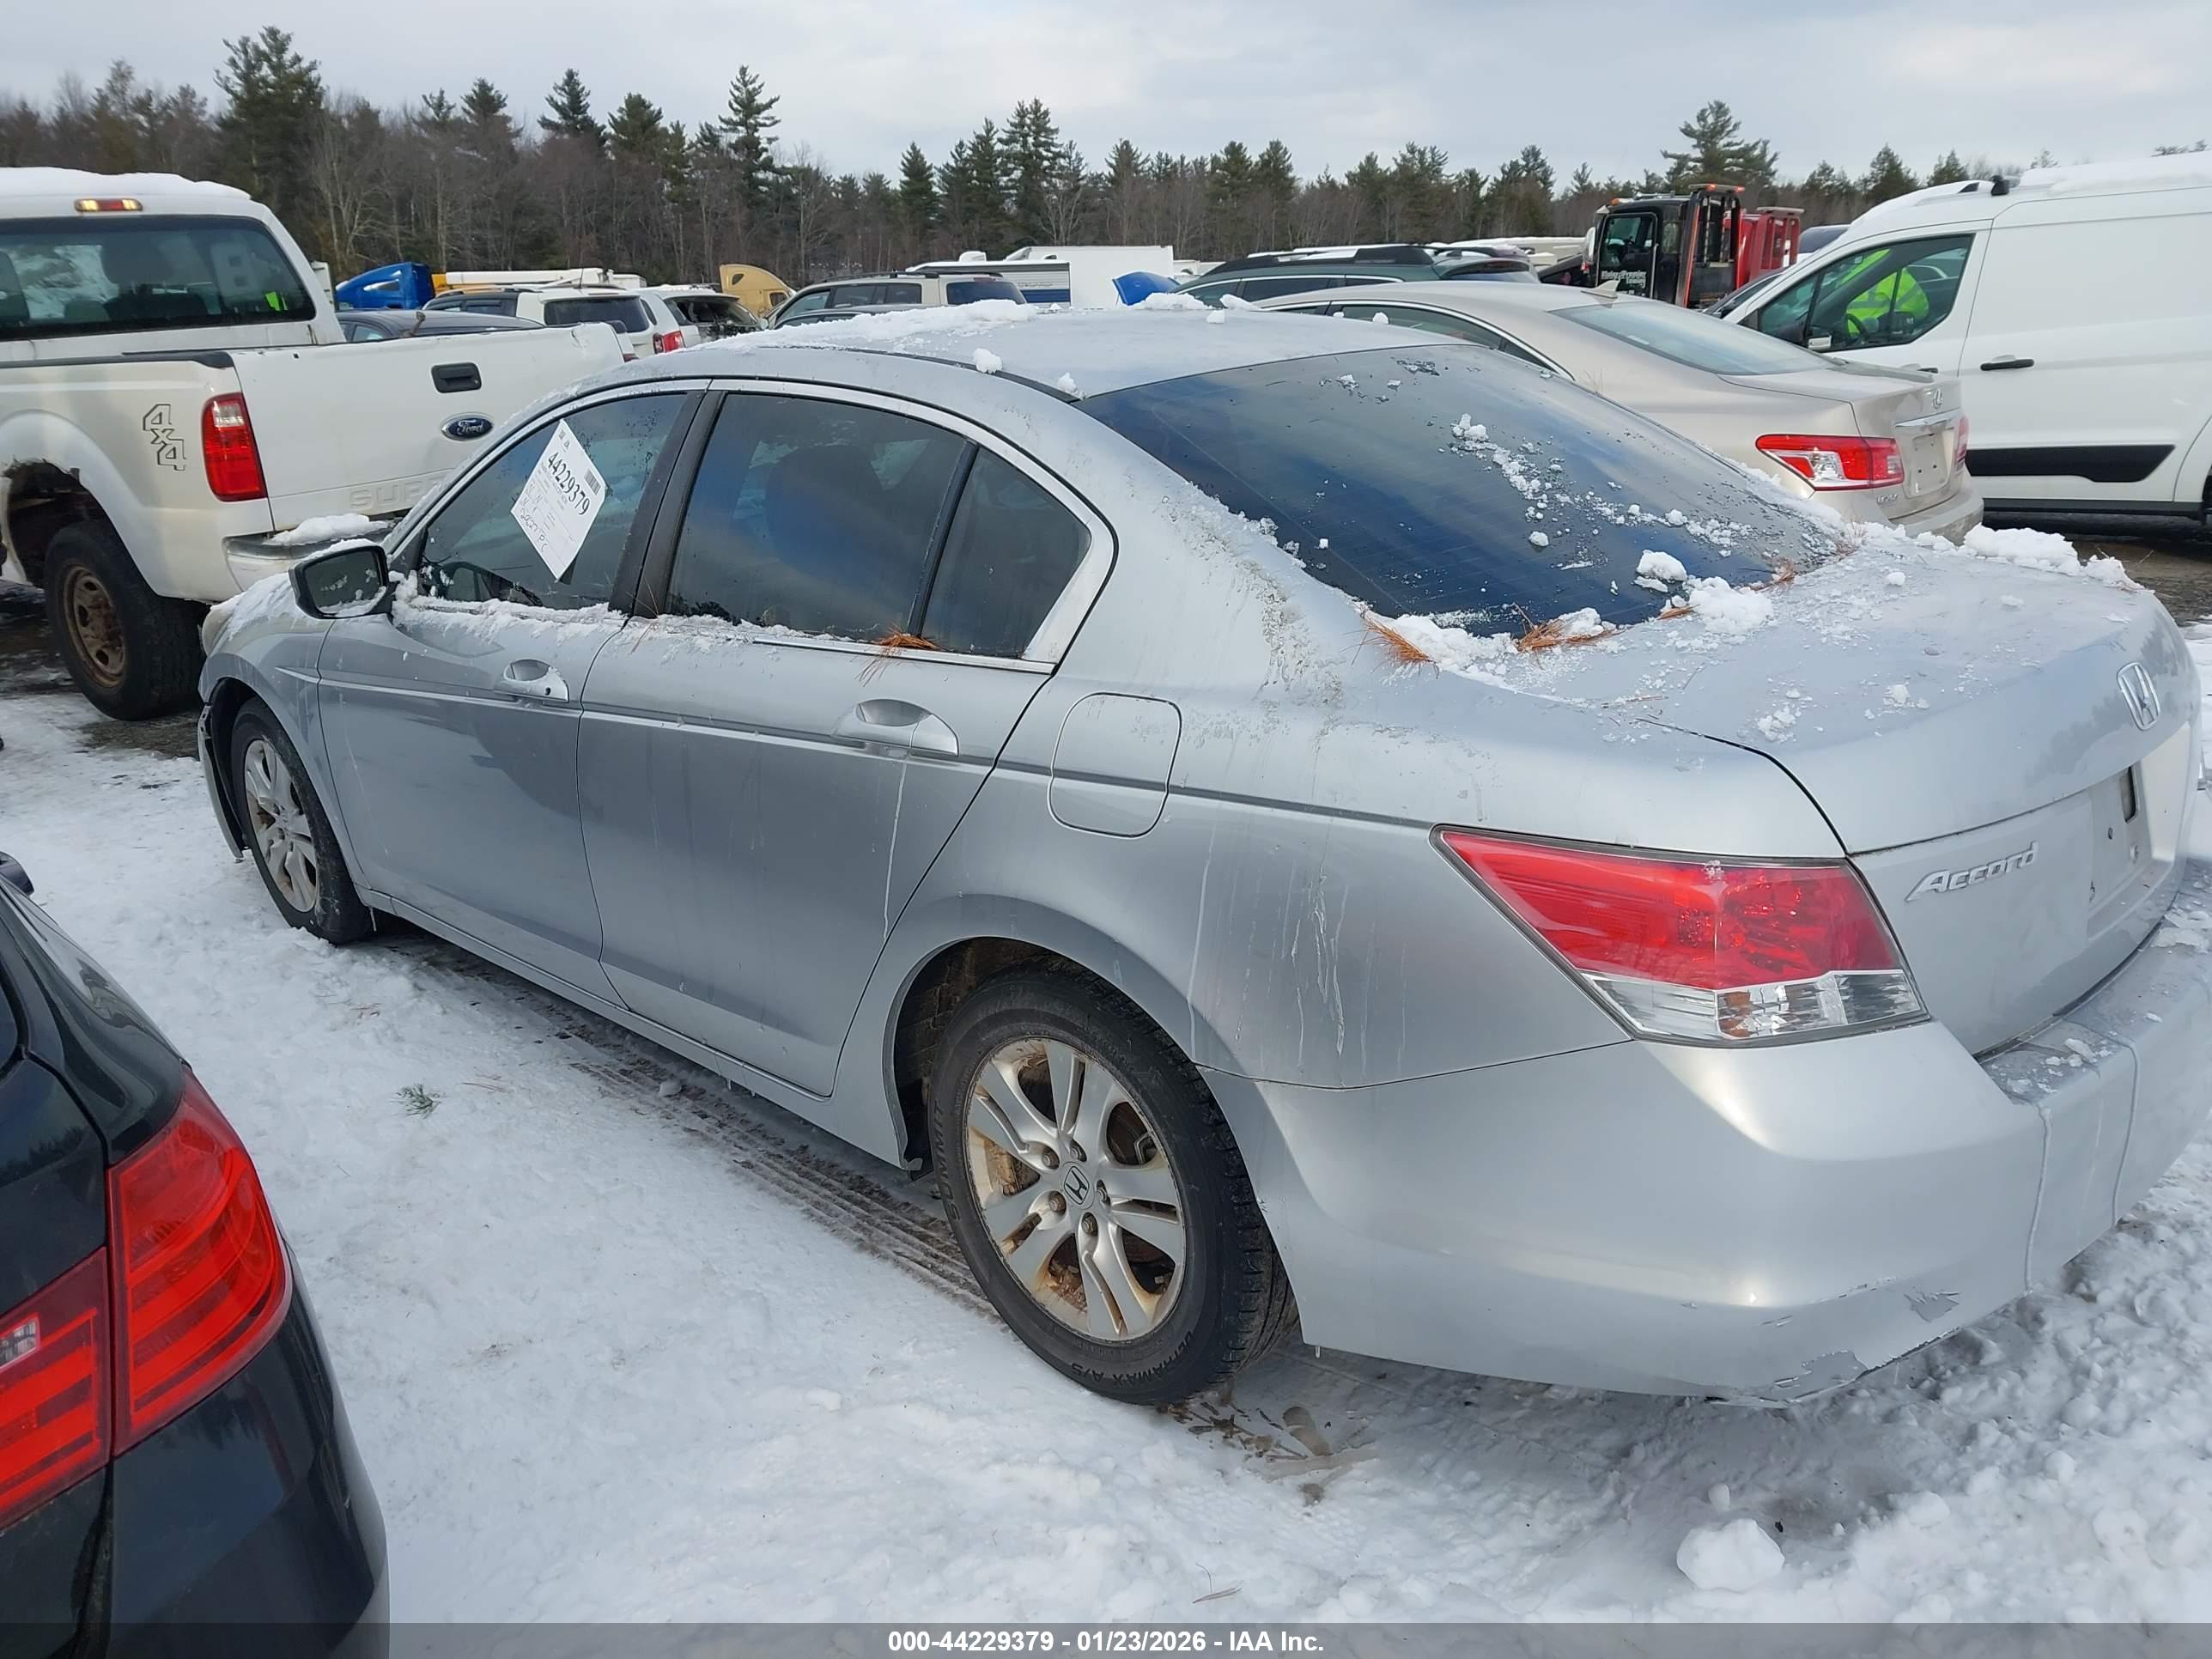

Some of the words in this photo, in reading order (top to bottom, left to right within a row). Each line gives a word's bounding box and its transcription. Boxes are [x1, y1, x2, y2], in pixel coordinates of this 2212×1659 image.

[457, 419, 484, 435] Ford
[548, 452, 590, 515] 44229379
[1905, 841, 2039, 902] Accord
